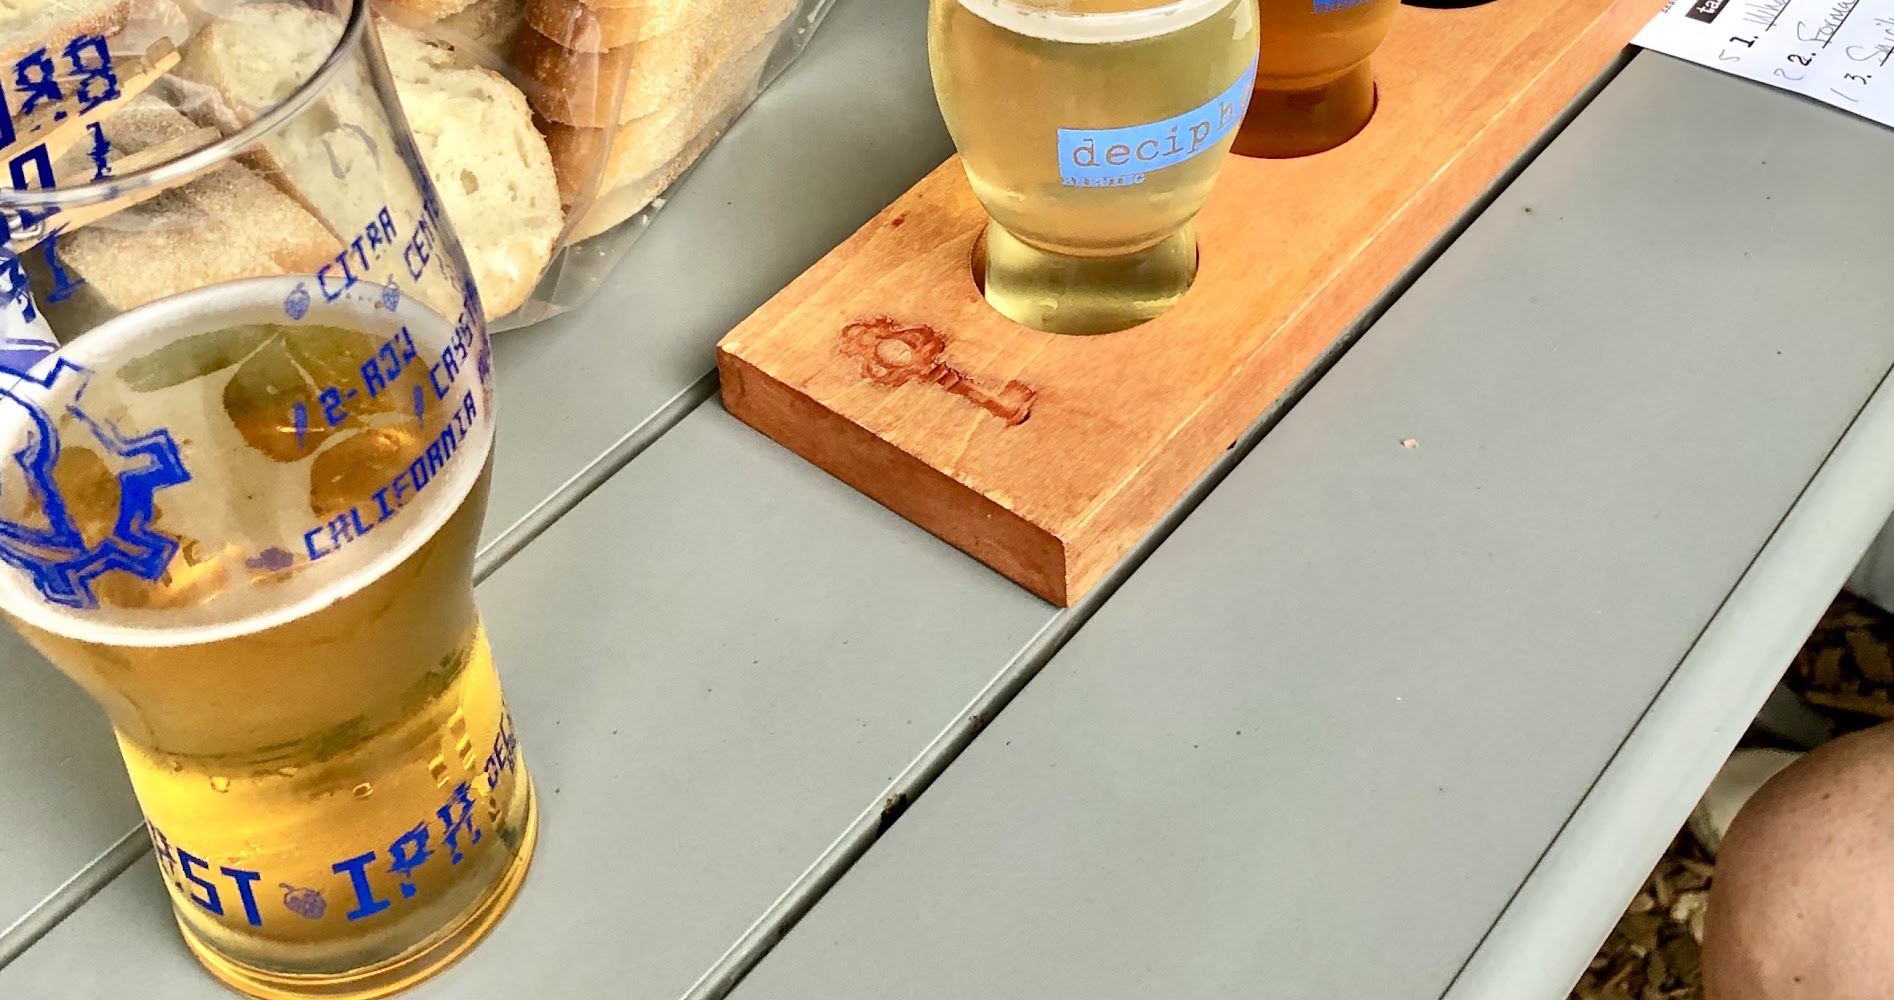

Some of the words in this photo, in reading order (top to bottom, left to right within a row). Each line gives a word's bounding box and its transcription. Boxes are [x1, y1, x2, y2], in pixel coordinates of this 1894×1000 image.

[1729, 35, 1758, 48] 1.
[1787, 52, 1816, 66] 2.
[1844, 72, 1872, 86] 3.
[317, 205, 397, 303] CITRA
[304, 390, 477, 561] CALIFORNIA
[332, 781, 482, 922] IPA
